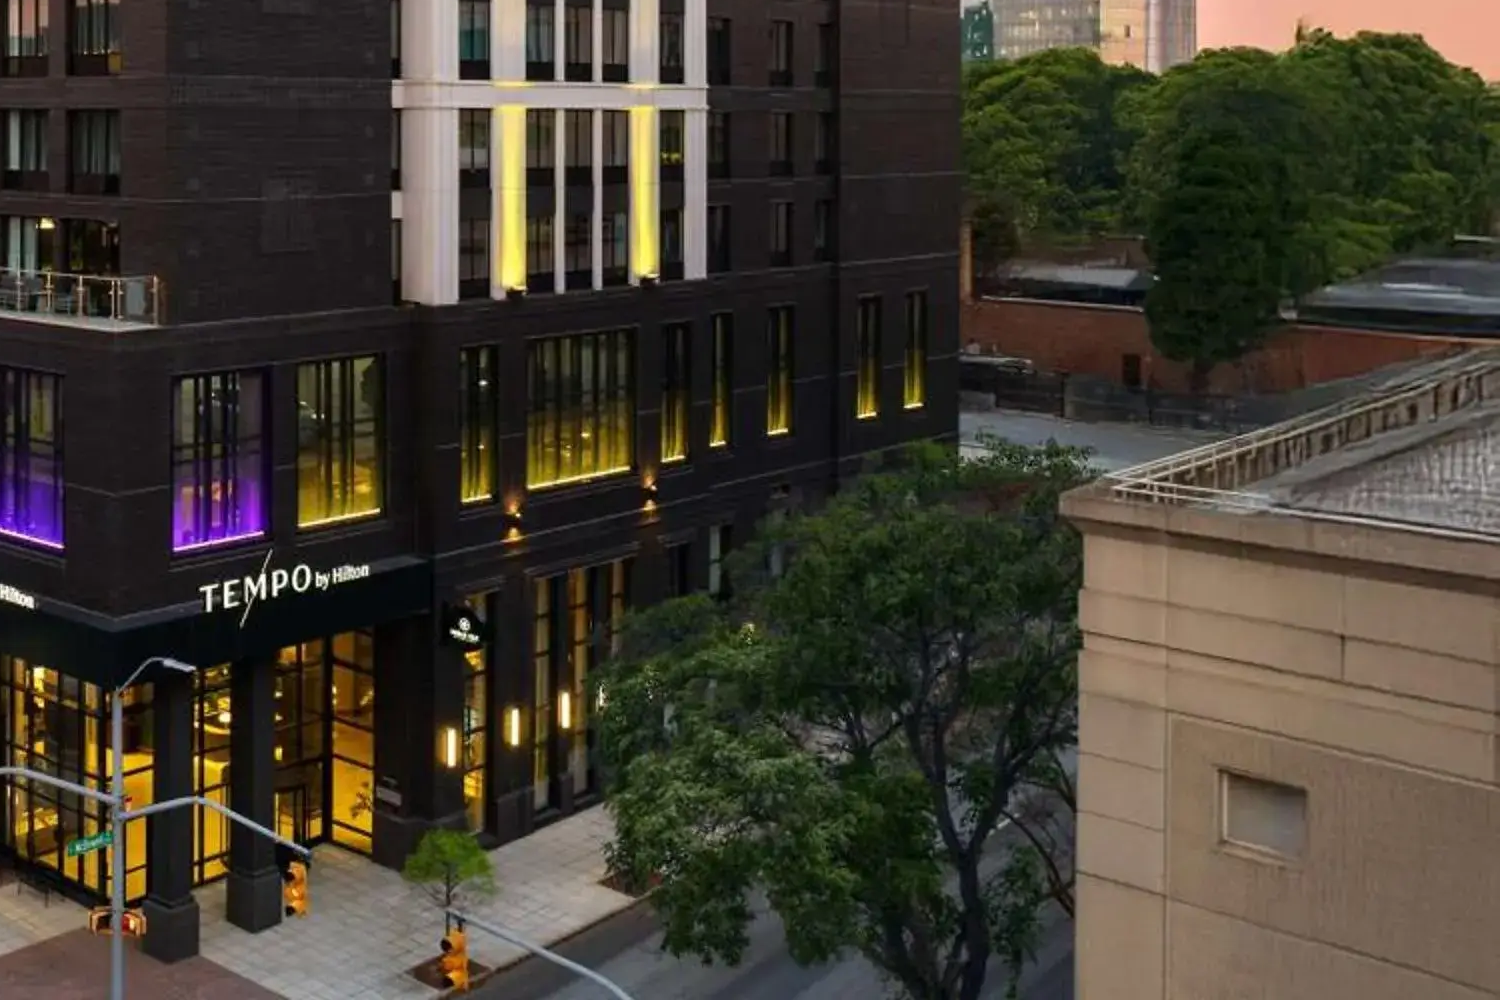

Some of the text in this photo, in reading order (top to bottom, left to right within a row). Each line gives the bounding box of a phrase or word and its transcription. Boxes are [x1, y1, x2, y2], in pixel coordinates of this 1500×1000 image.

[199, 548, 370, 629] TEMPO by Hilton
